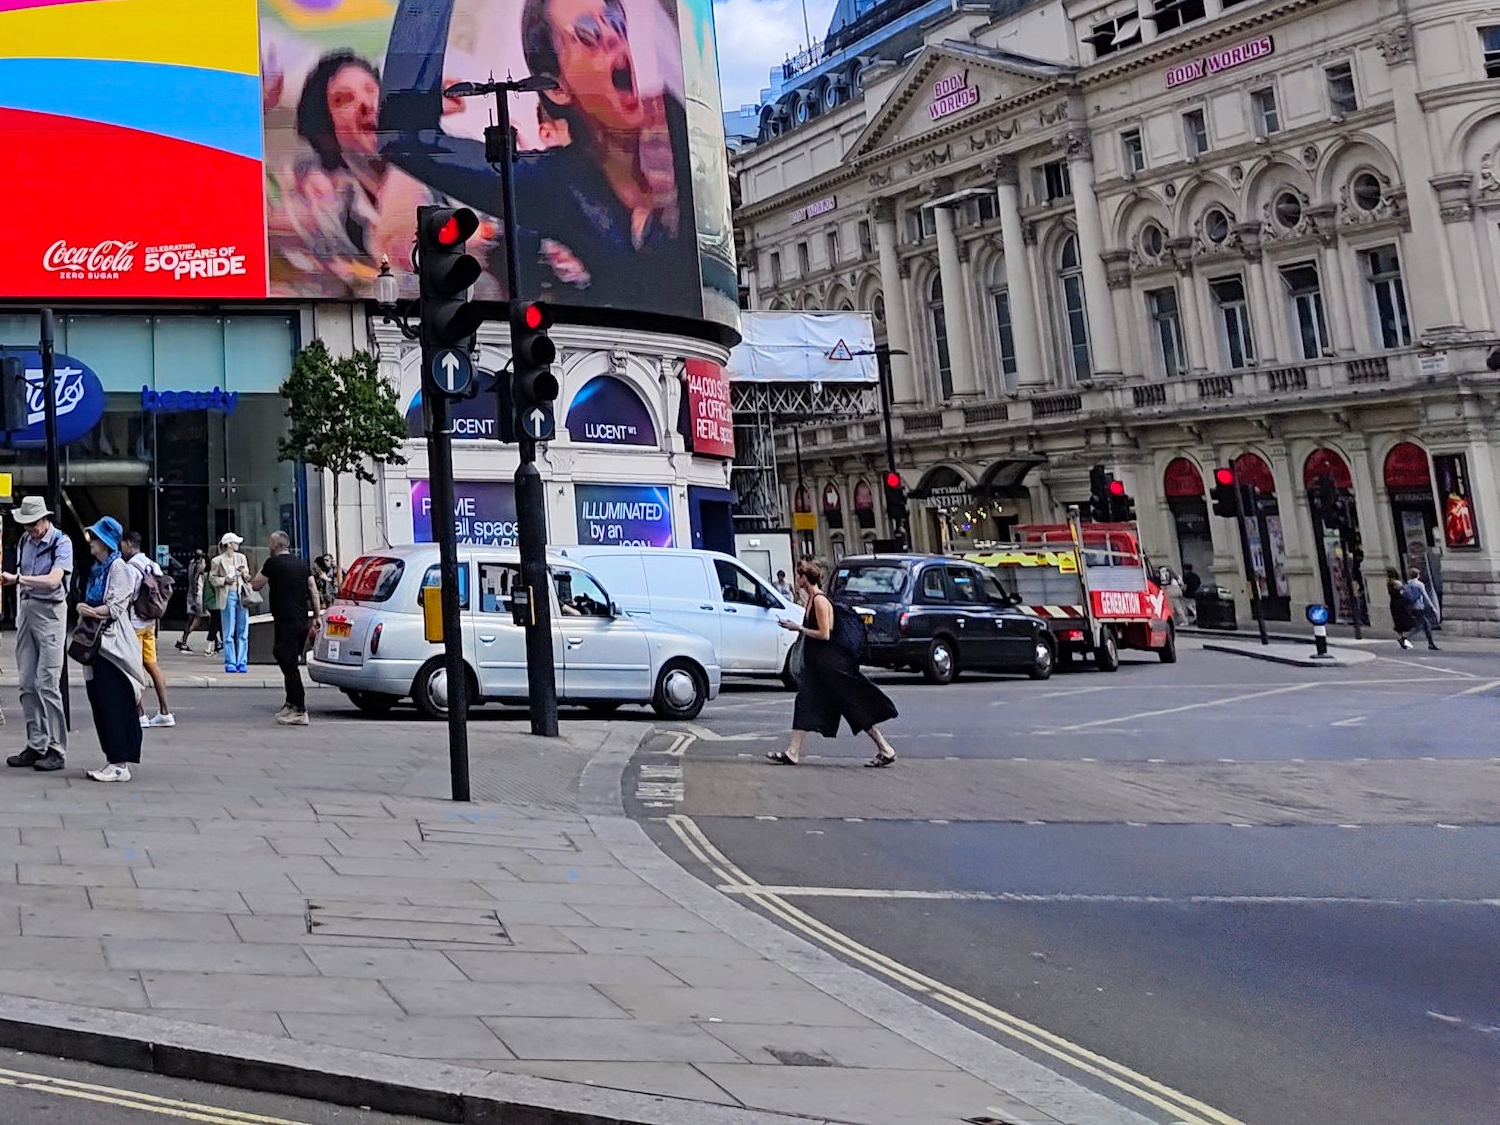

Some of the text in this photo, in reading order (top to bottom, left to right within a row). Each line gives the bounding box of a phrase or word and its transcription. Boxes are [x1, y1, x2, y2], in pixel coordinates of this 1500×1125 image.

[1165, 36, 1272, 88] BODY WORLDS
[933, 71, 966, 100] BODY
[928, 86, 977, 121] WORLDS
[43, 239, 139, 272] Coca-Cola
[144, 246, 236, 272] 50 YEARS OF
[145, 243, 196, 253] CELEBRATING
[87, 272, 119, 280] SUGAR
[174, 255, 246, 280] PRIDE
[142, 385, 239, 414] beauty
[450, 419, 494, 434] UCENT
[585, 423, 627, 440] LUCENT
[421, 497, 476, 517] PME
[582, 501, 663, 521] ILLUMINATED
[474, 521, 518, 540] space
[590, 521, 623, 542] by an
[1100, 592, 1141, 615] GENERATION
